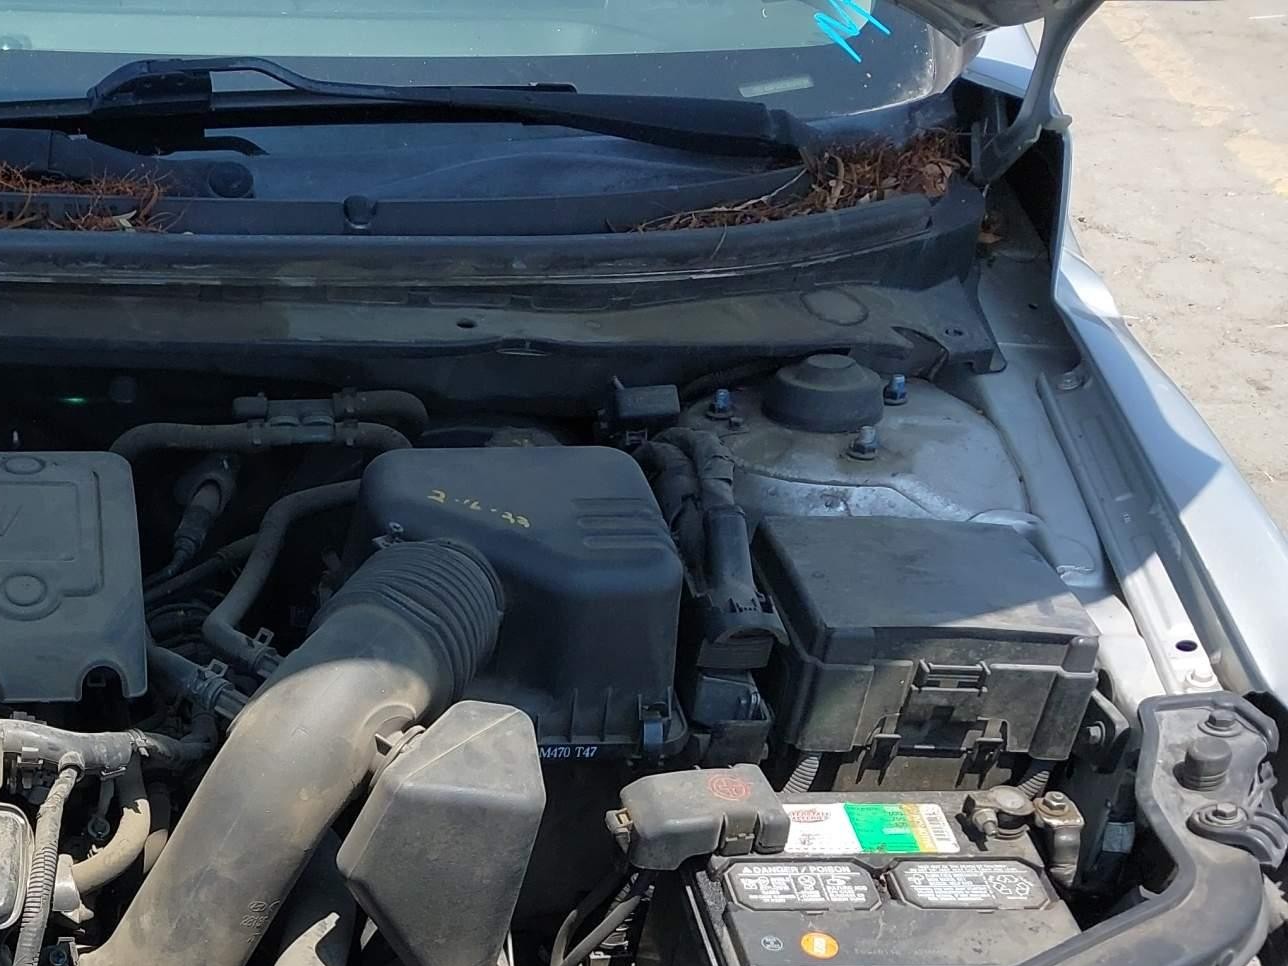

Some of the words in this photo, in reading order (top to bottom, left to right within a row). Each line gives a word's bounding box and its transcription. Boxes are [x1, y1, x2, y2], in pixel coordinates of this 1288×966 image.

[574, 746, 598, 758] T47
[752, 865, 799, 874] DANGER
[809, 865, 851, 874] POISON
